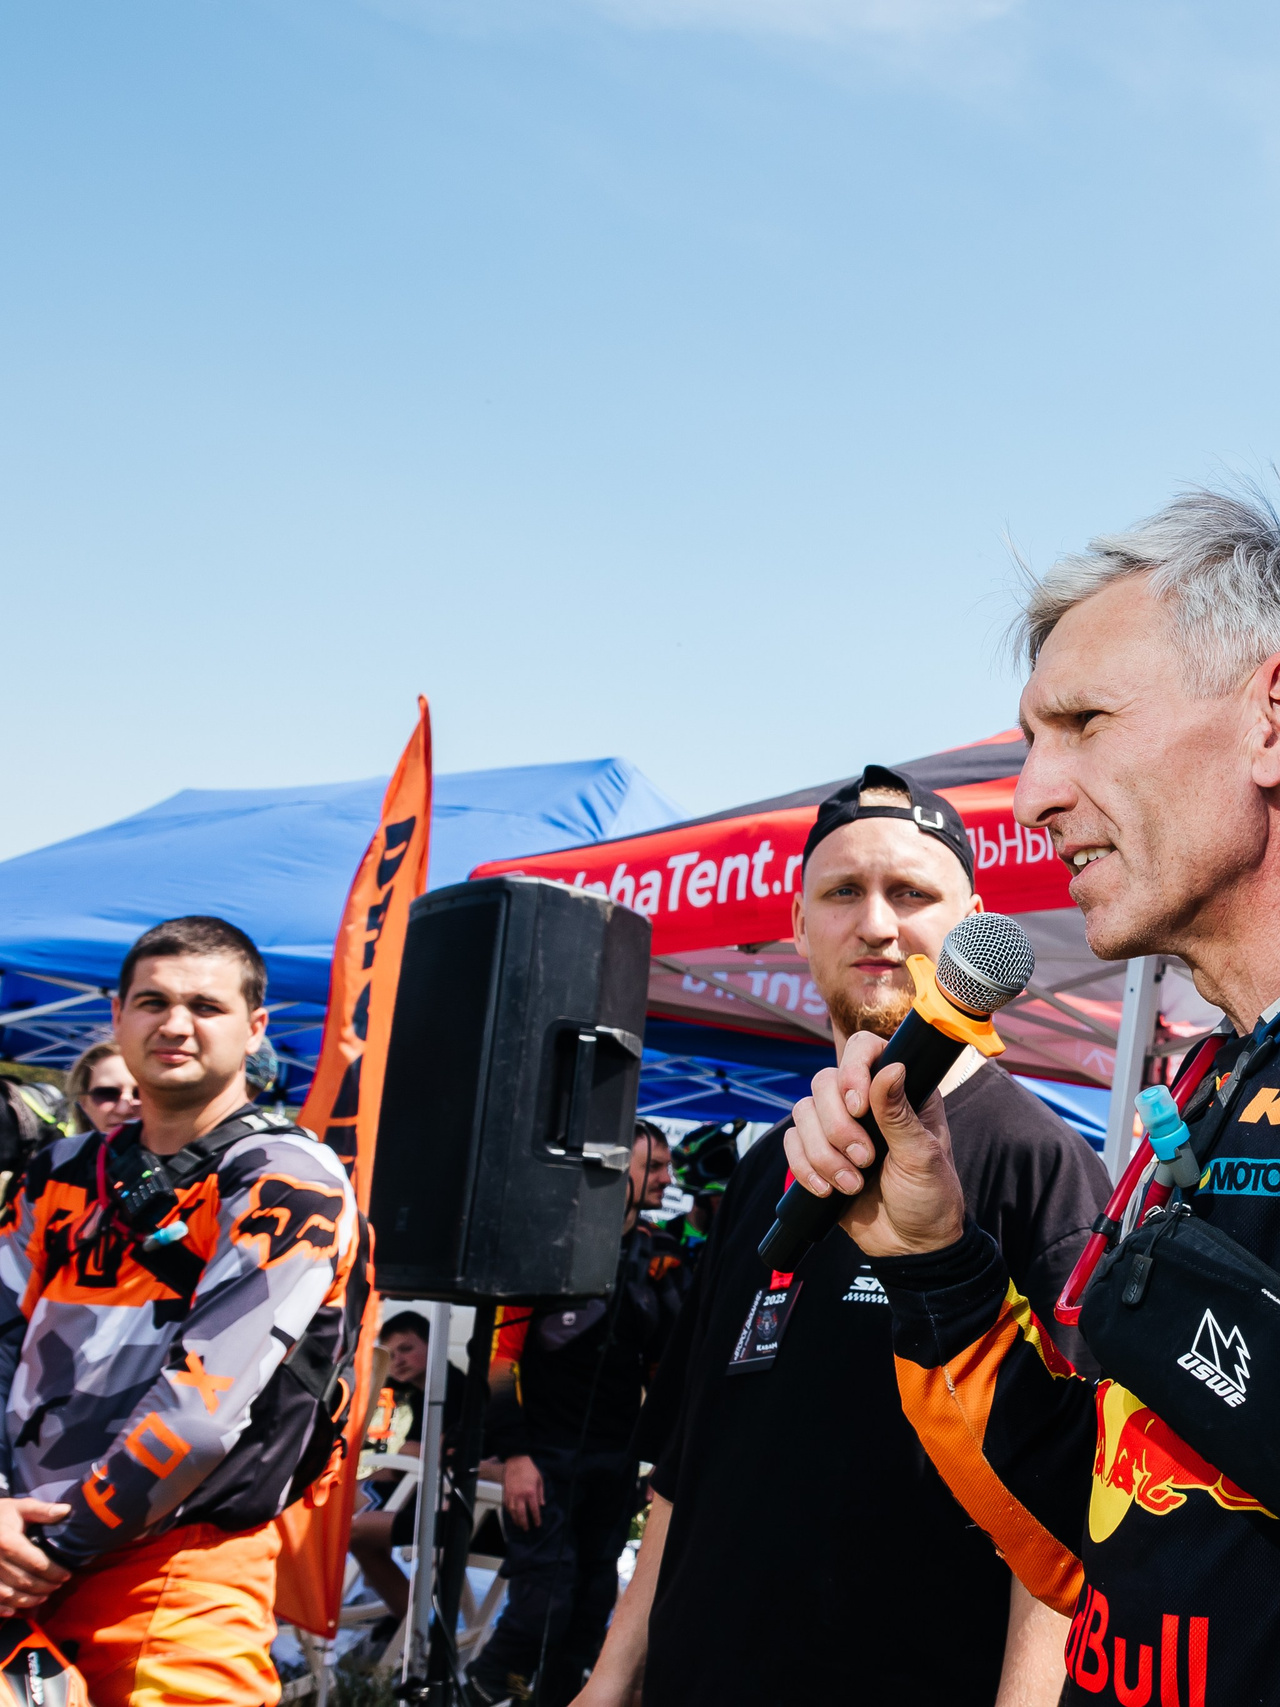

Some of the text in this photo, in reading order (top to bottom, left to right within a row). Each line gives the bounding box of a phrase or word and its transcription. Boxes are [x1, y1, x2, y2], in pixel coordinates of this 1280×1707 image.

[762, 1292, 787, 1307] 2025
[1177, 1352, 1246, 1408] USWE
[82, 1350, 236, 1529] FOX
